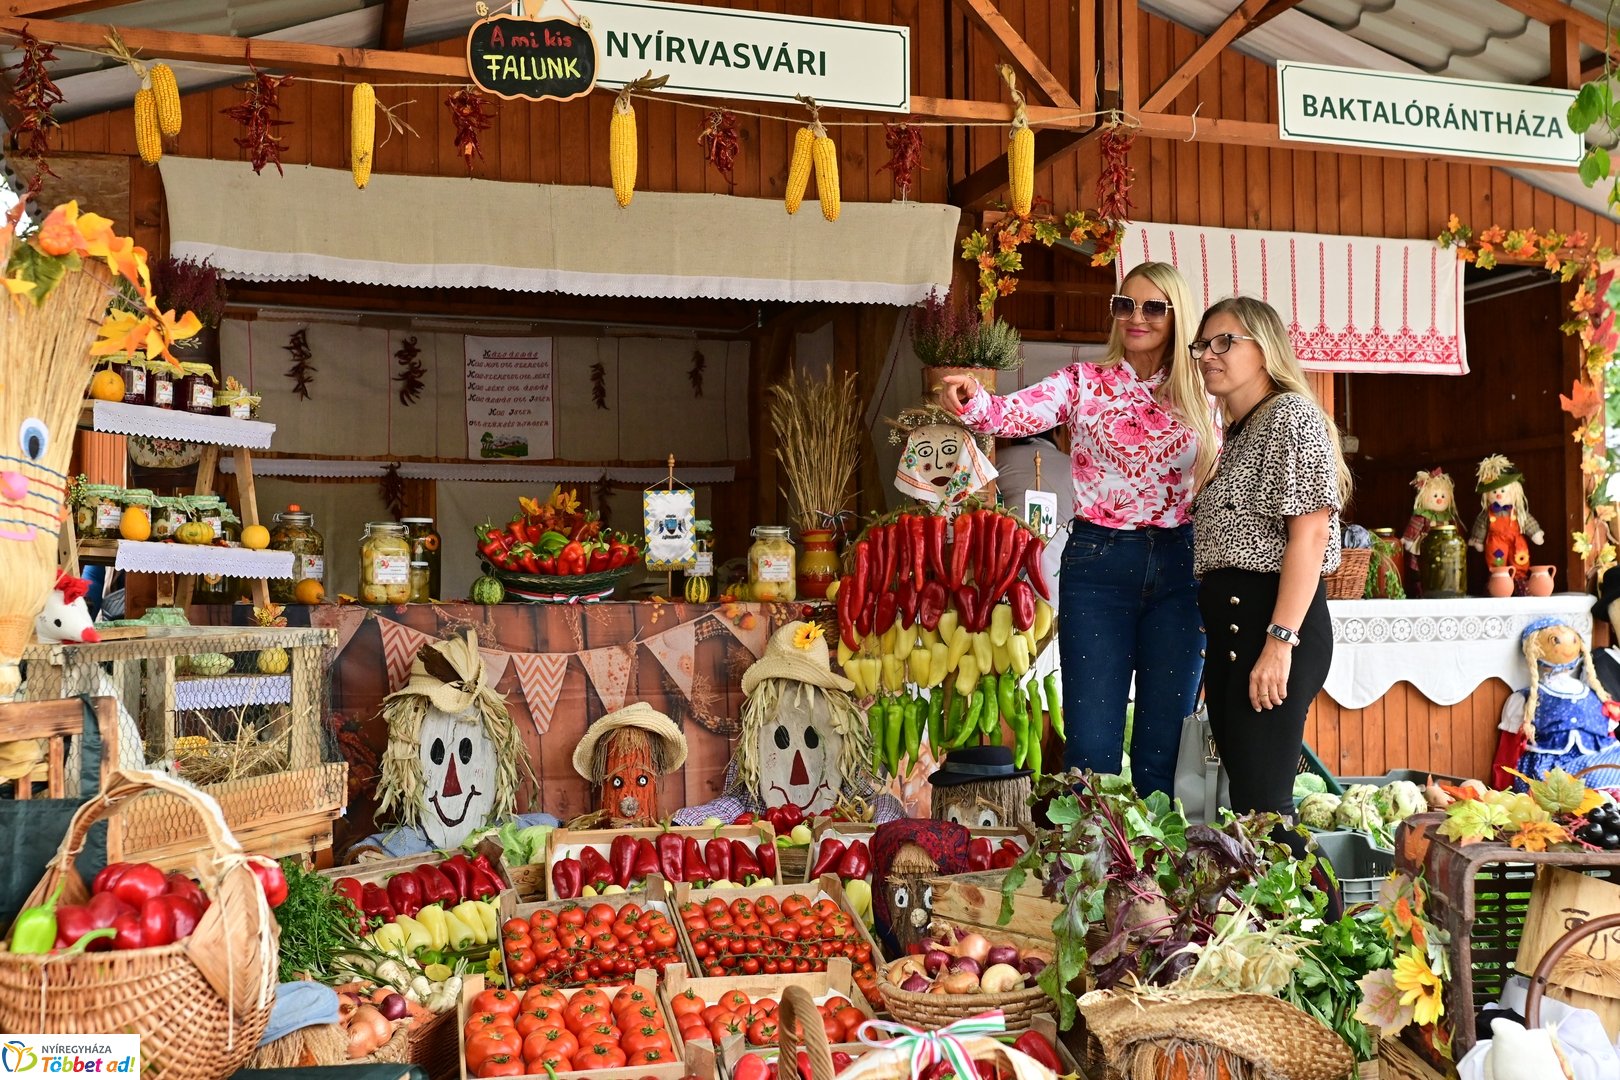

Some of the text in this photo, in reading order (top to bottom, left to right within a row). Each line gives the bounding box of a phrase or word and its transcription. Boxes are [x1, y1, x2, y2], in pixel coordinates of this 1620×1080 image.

[489, 25, 573, 49] A mi kis
[606, 30, 826, 76] NYÍRVASVÁRI
[483, 54, 581, 81] FALUNK
[1302, 94, 1564, 139] BAKTALÓRÁNTHÁZA
